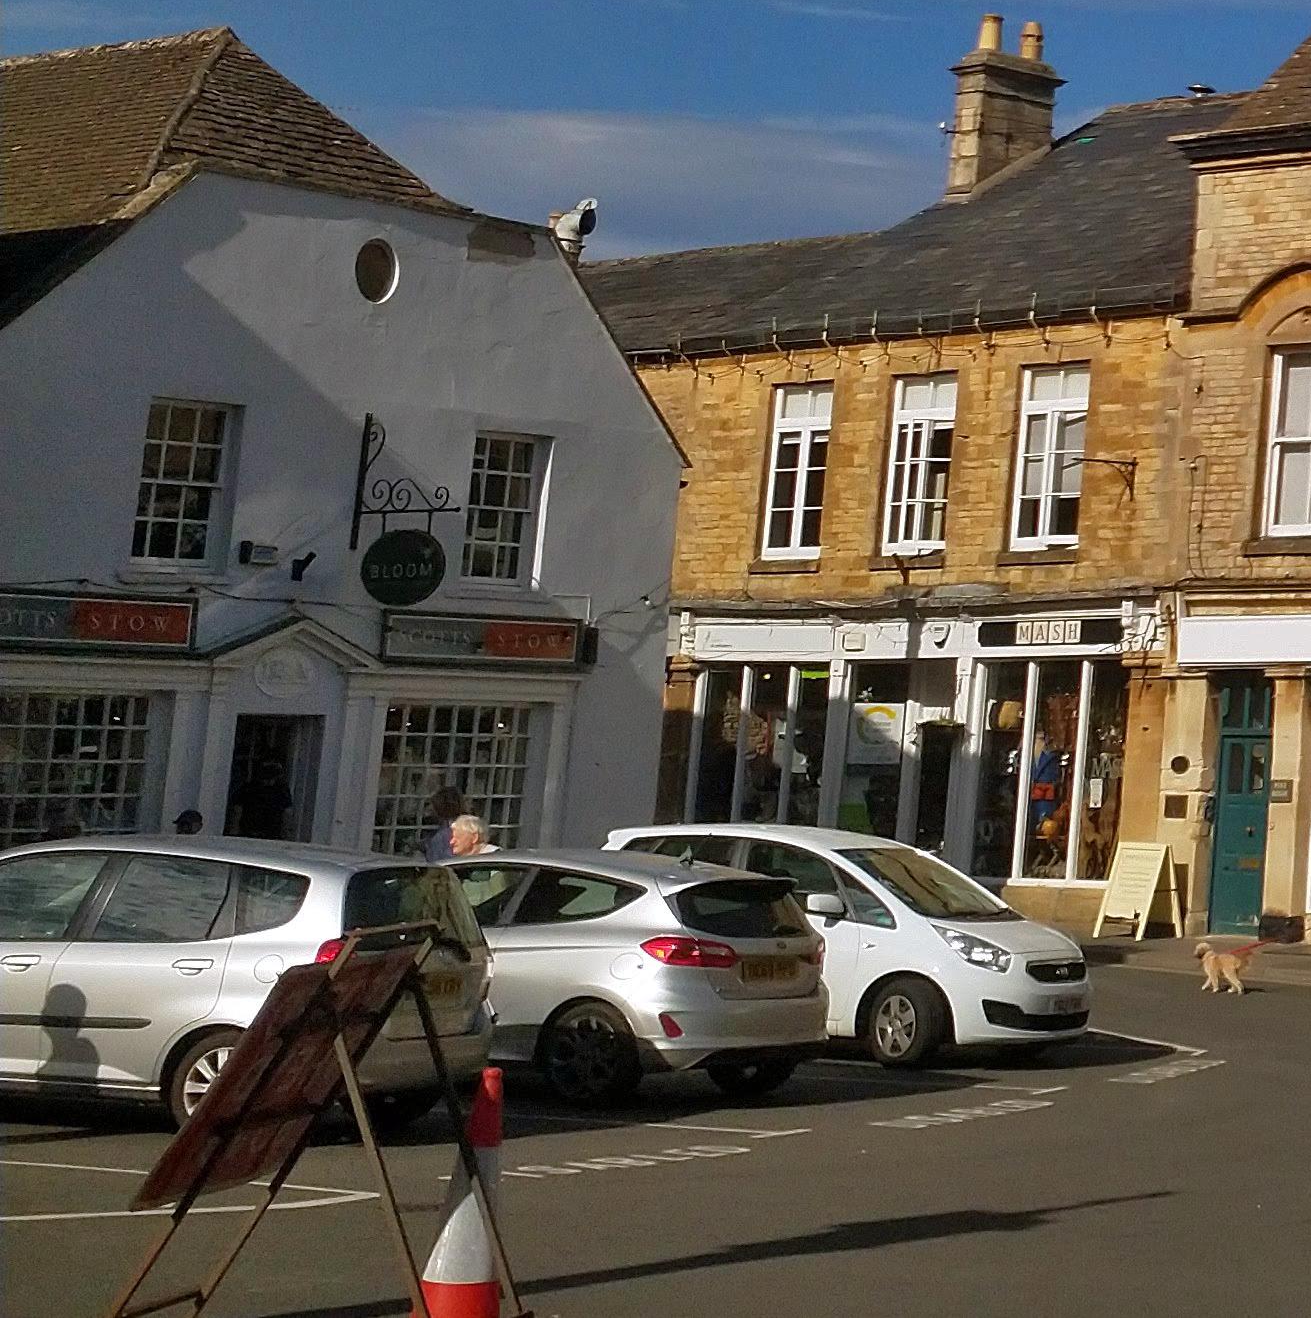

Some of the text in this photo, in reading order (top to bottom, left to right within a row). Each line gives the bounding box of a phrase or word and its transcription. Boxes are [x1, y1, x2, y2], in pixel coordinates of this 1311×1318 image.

[368, 562, 433, 580] BLOOM
[90, 613, 169, 633] STOW
[1018, 623, 1079, 642] MASH
[498, 633, 562, 649] STOW
[438, 1144, 752, 1181] ISABLED
